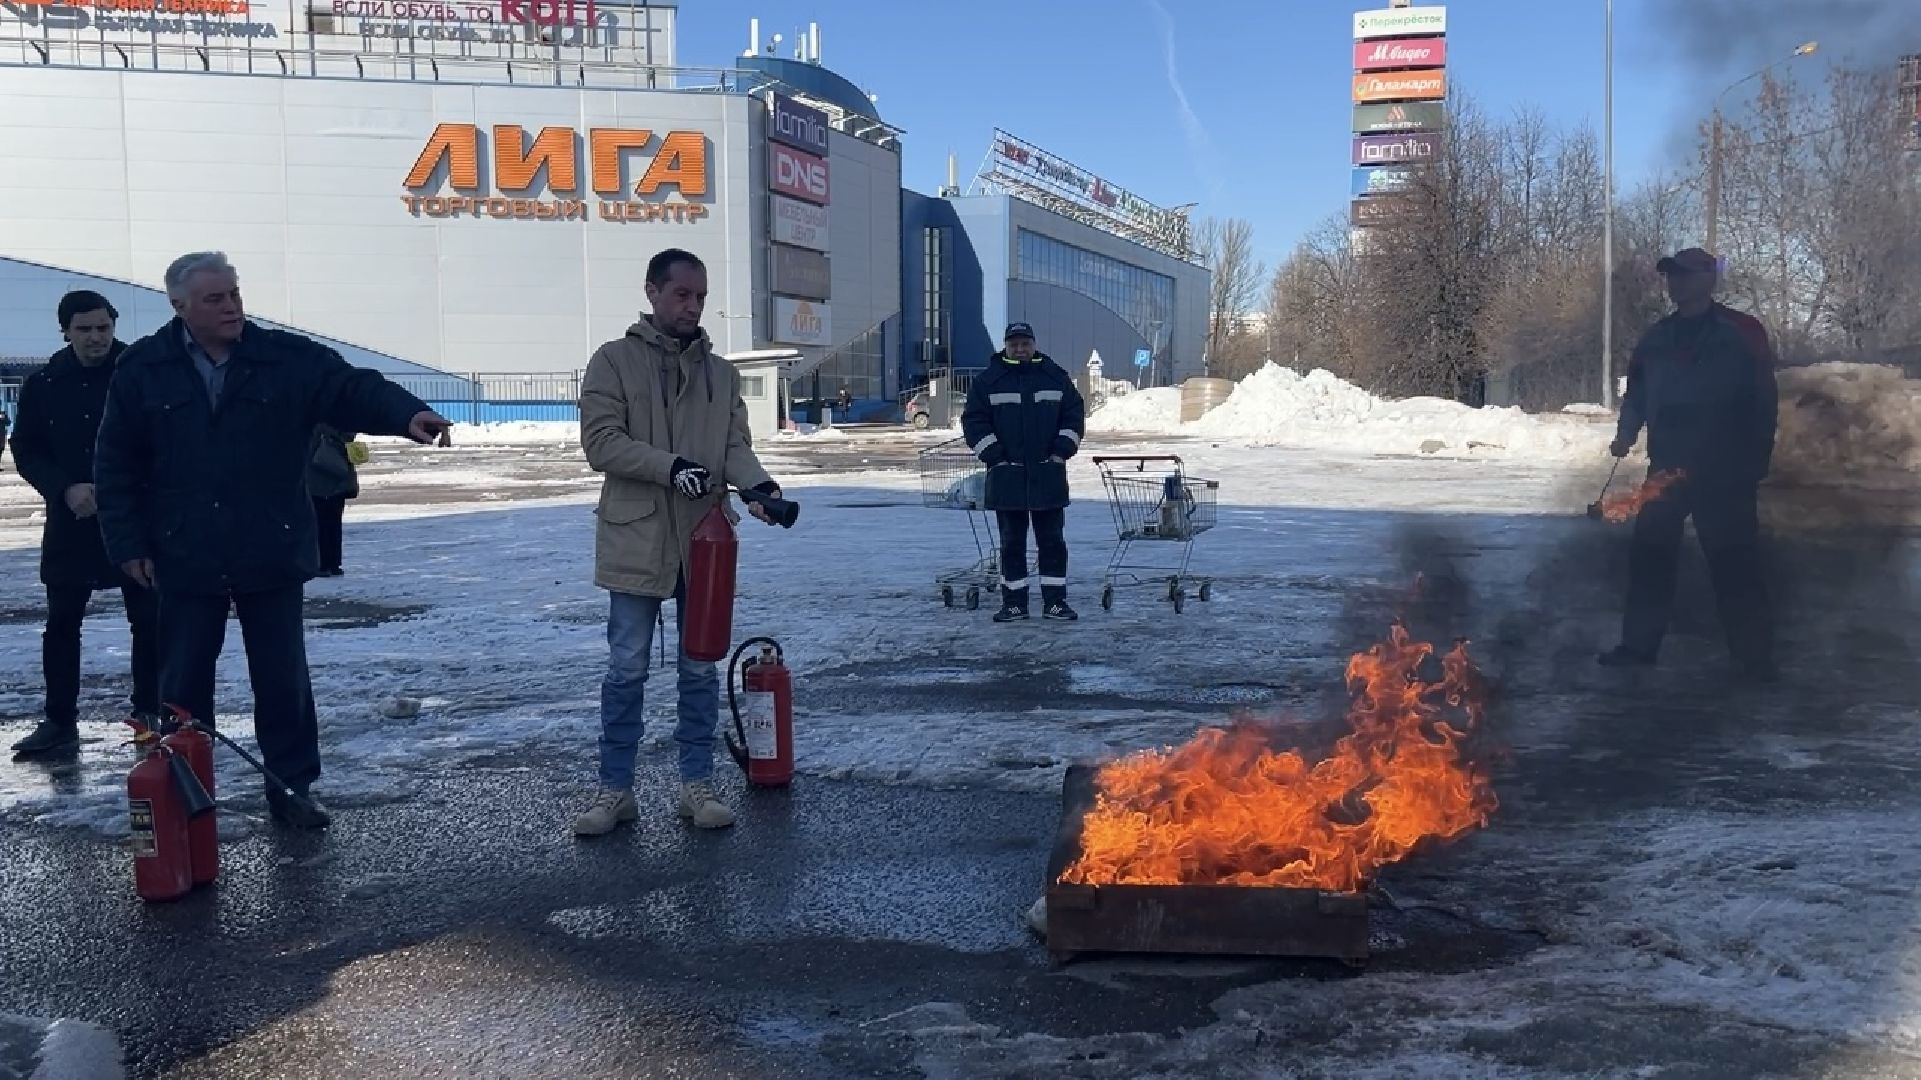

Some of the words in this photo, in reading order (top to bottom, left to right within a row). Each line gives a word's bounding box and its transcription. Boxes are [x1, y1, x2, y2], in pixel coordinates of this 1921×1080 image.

[333, 0, 385, 17] ЕСЛИ
[1369, 79, 1440, 92] Галамарт
[403, 123, 706, 195] ЛИГА
[777, 152, 827, 196] DNS
[400, 196, 586, 219] ТОРГОВЫЙ
[599, 200, 706, 223] ЦЕНТР
[791, 313, 822, 335] ЛИГА
